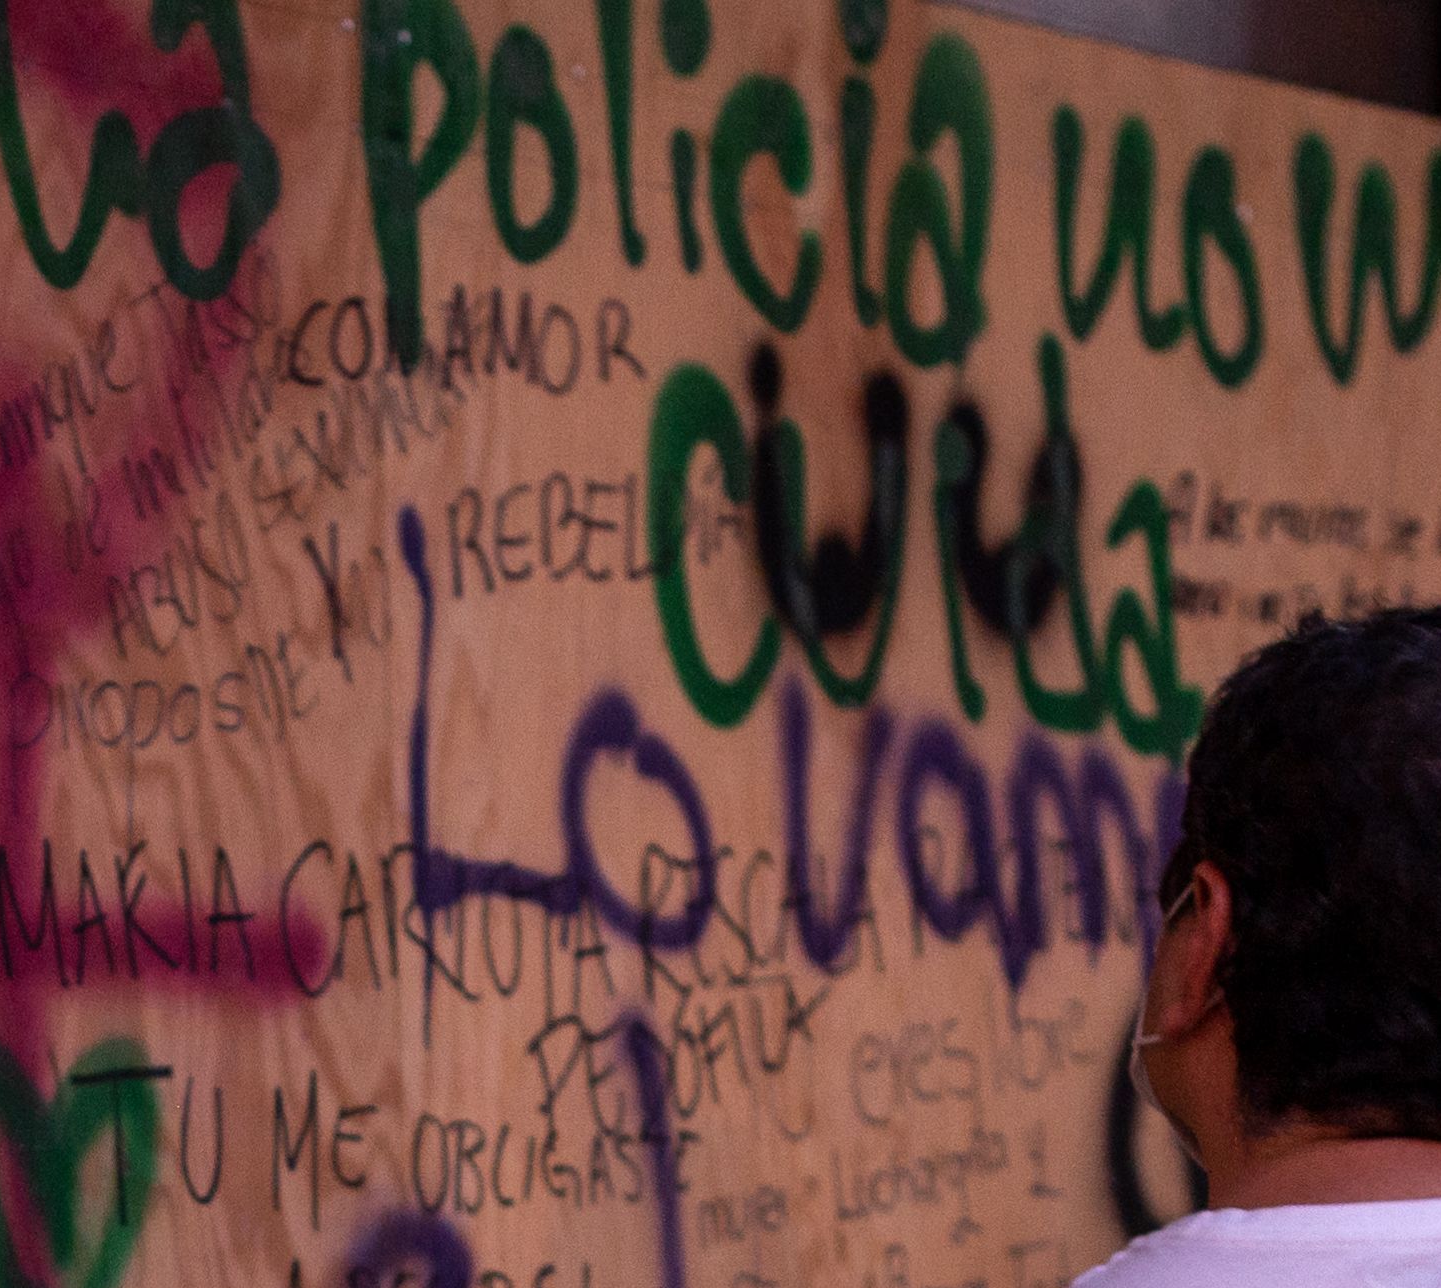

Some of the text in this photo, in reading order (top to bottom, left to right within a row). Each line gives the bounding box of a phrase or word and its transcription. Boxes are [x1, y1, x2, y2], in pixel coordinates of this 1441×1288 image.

[357, 0, 997, 385] policia
[1050, 103, 1267, 388] no
[442, 283, 650, 396] AMOR
[272, 1070, 379, 1232] ME
